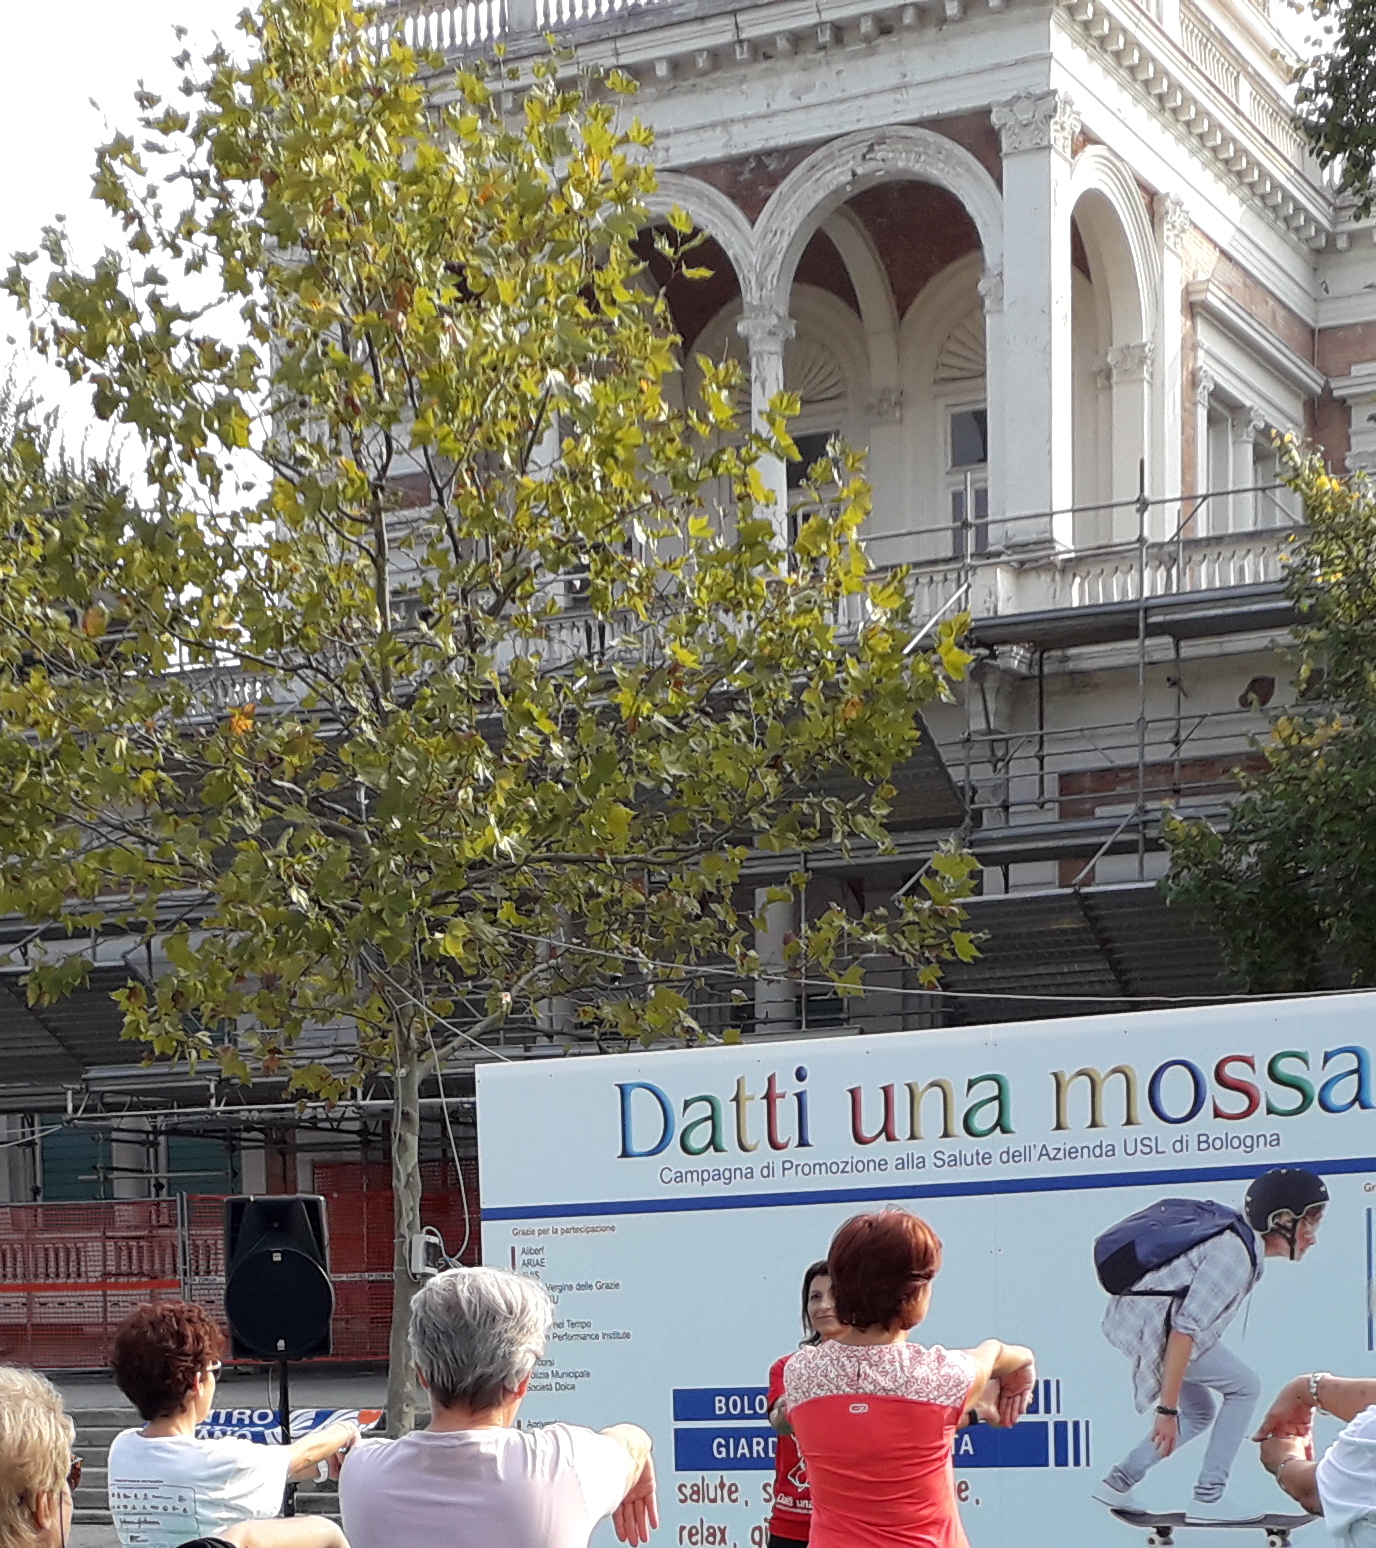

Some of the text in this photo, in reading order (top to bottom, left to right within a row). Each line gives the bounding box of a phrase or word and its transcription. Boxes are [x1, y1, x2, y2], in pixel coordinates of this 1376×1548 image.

[614, 1065, 814, 1160] Datti
[846, 1073, 1017, 1146] una
[659, 1131, 1281, 1188] Campagna di Promozione alla Salute dell'Azienda USL di Bologna
[714, 1395, 769, 1415] BOLO
[712, 1437, 777, 1459] GIARD
